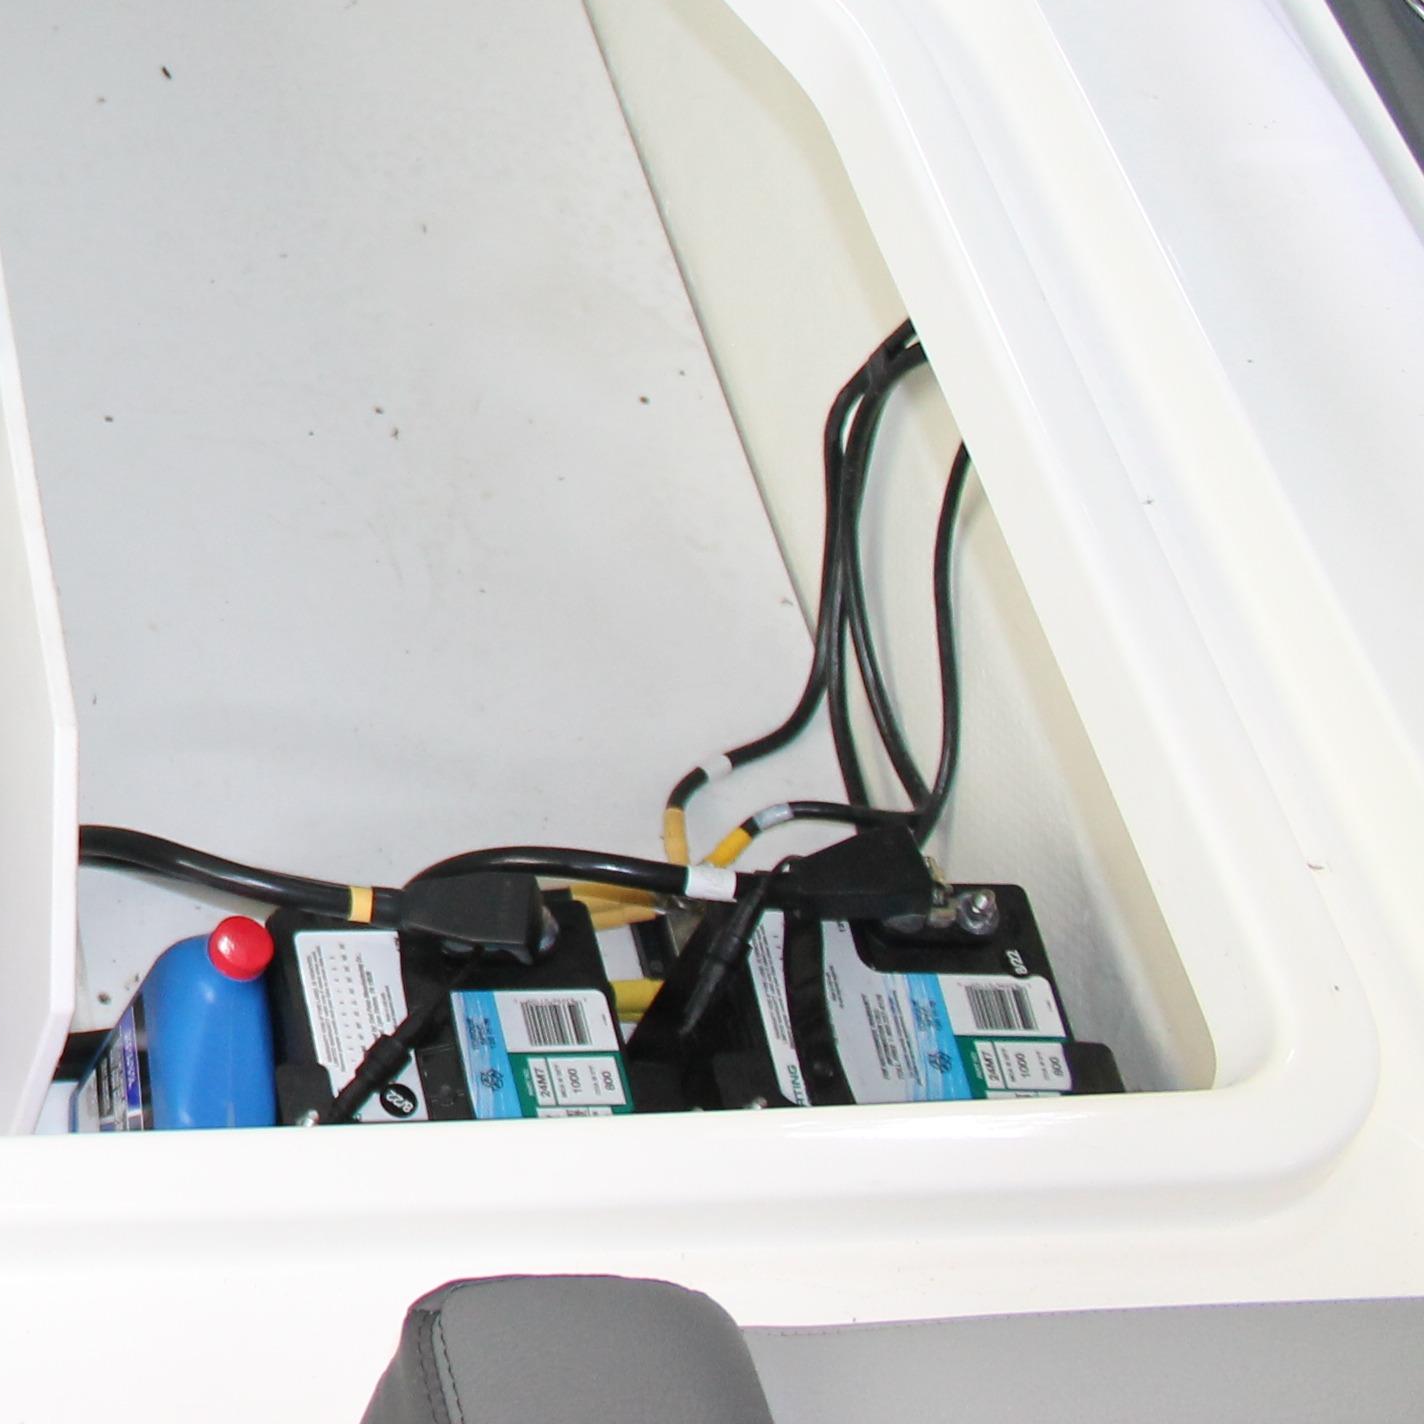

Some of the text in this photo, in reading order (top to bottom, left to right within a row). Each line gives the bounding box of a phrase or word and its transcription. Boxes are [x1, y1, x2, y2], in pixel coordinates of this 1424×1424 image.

[1005, 949, 1029, 976] 8/22
[1015, 1052, 1031, 1078] 1000
[1049, 1056, 1064, 1077] 800
[534, 1066, 551, 1097] 24M7
[567, 1068, 583, 1094] 1000
[601, 1070, 615, 1091] 800
[386, 1089, 413, 1113] 8/22
